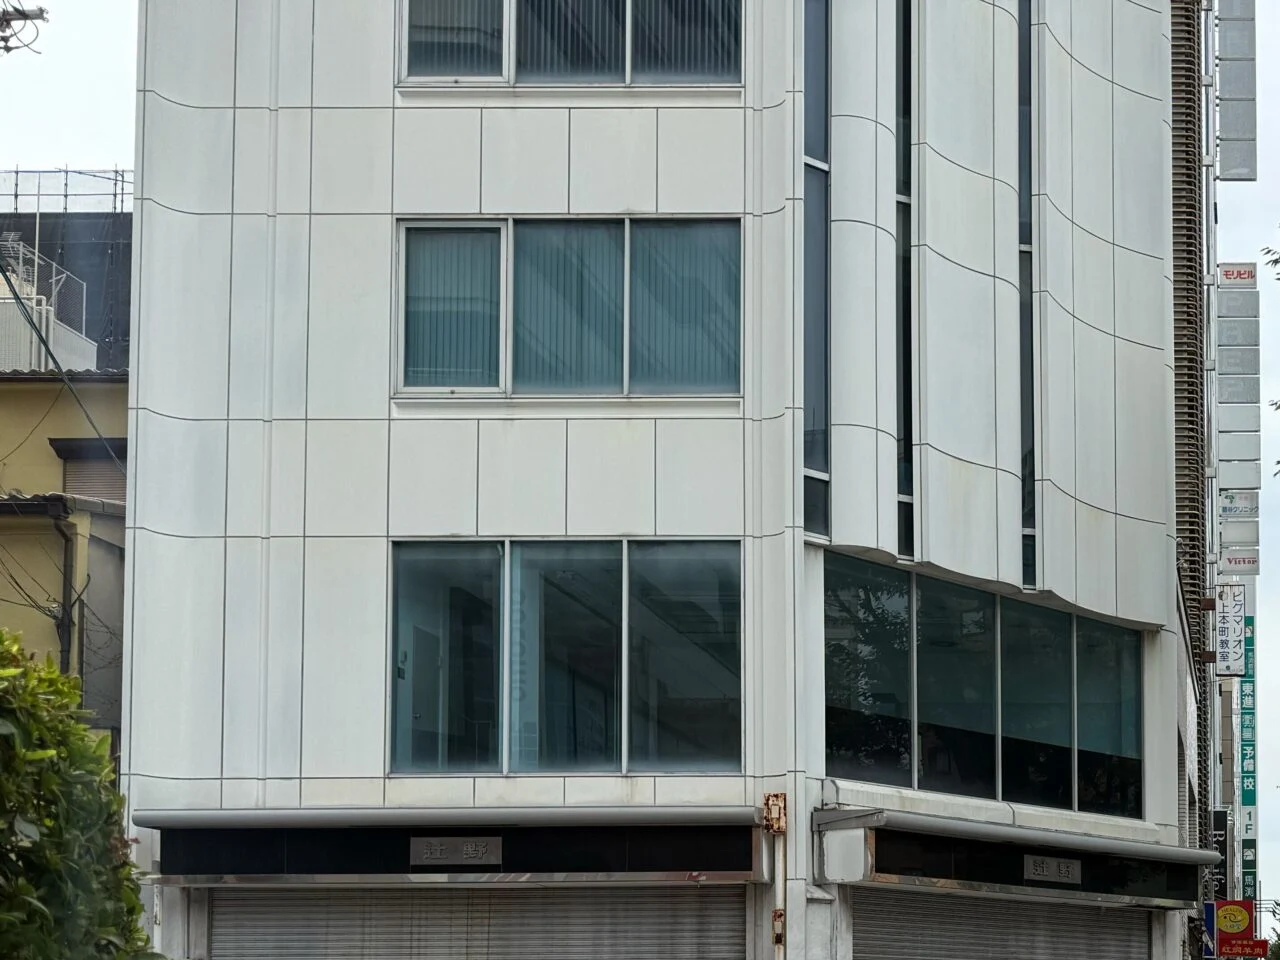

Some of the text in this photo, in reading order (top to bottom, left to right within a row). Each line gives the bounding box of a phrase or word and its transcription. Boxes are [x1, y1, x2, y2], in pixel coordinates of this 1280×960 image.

[1227, 557, 1257, 565] Victor
[1218, 602, 1230, 662] 上本町教室
